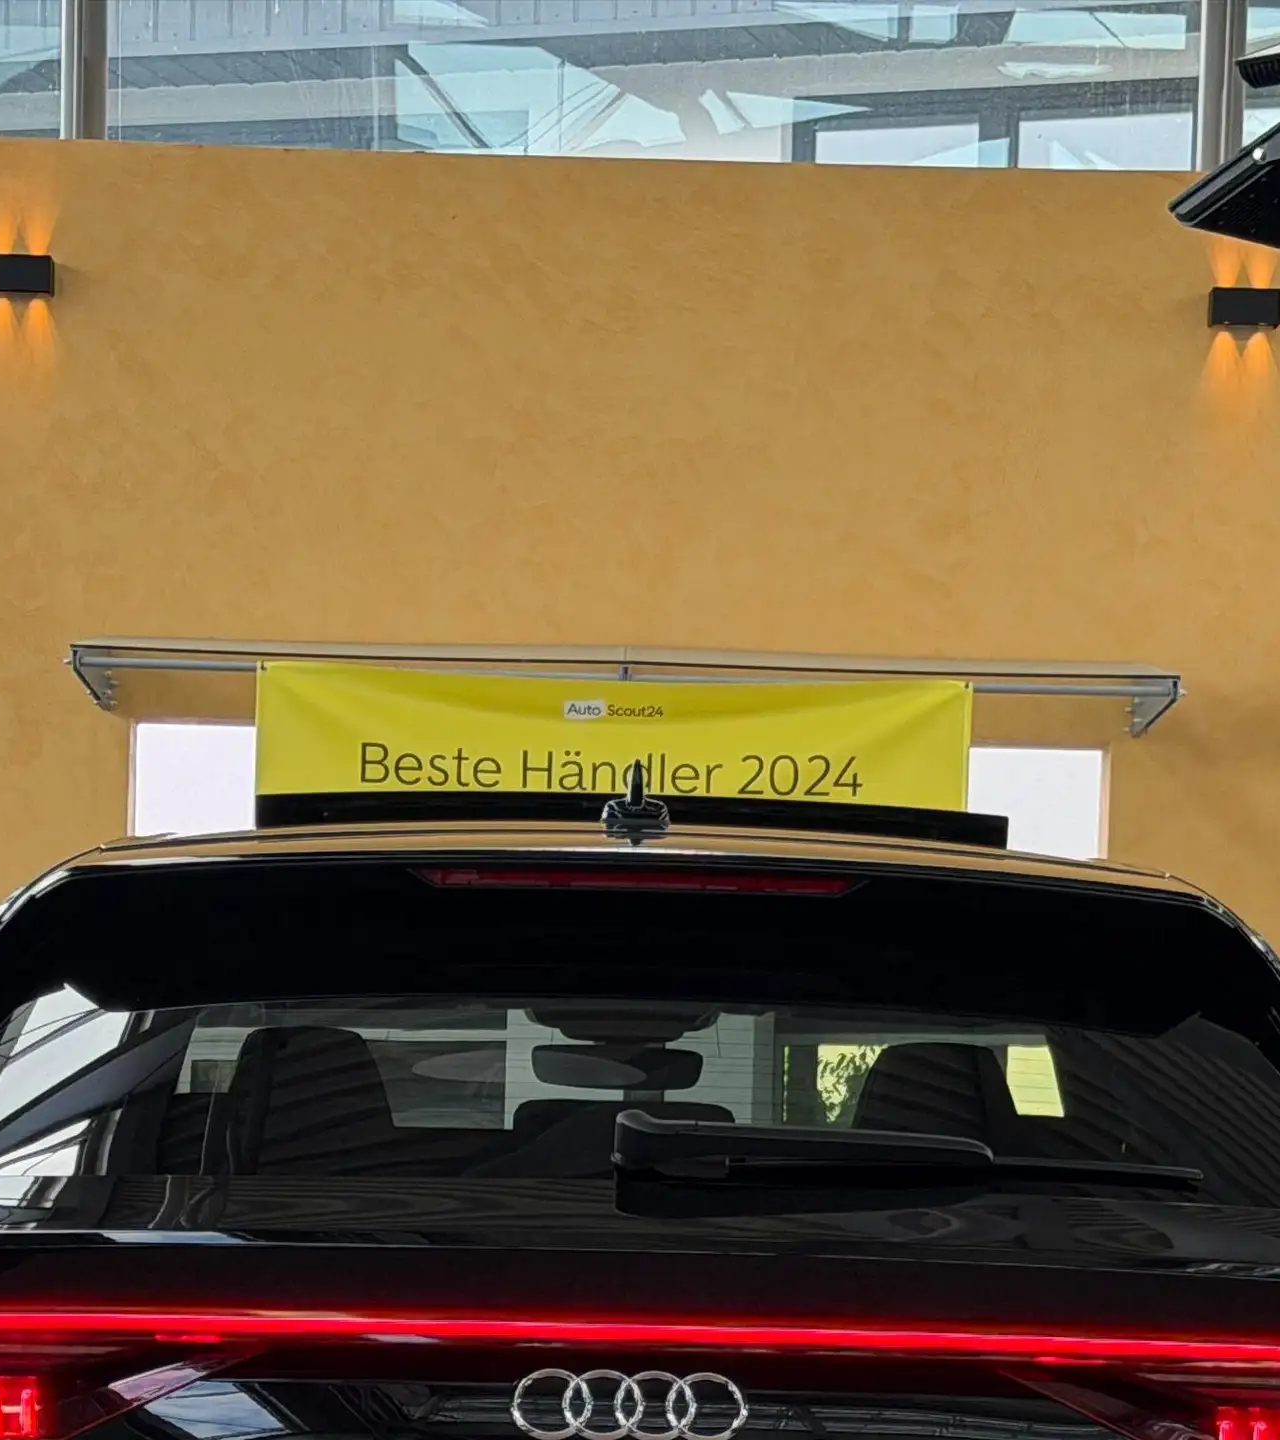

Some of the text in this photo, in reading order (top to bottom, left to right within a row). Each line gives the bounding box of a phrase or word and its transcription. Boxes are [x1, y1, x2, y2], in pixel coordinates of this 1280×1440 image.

[567, 704, 664, 718] Auto Scout24
[359, 742, 864, 797] Beste Händler 2024
